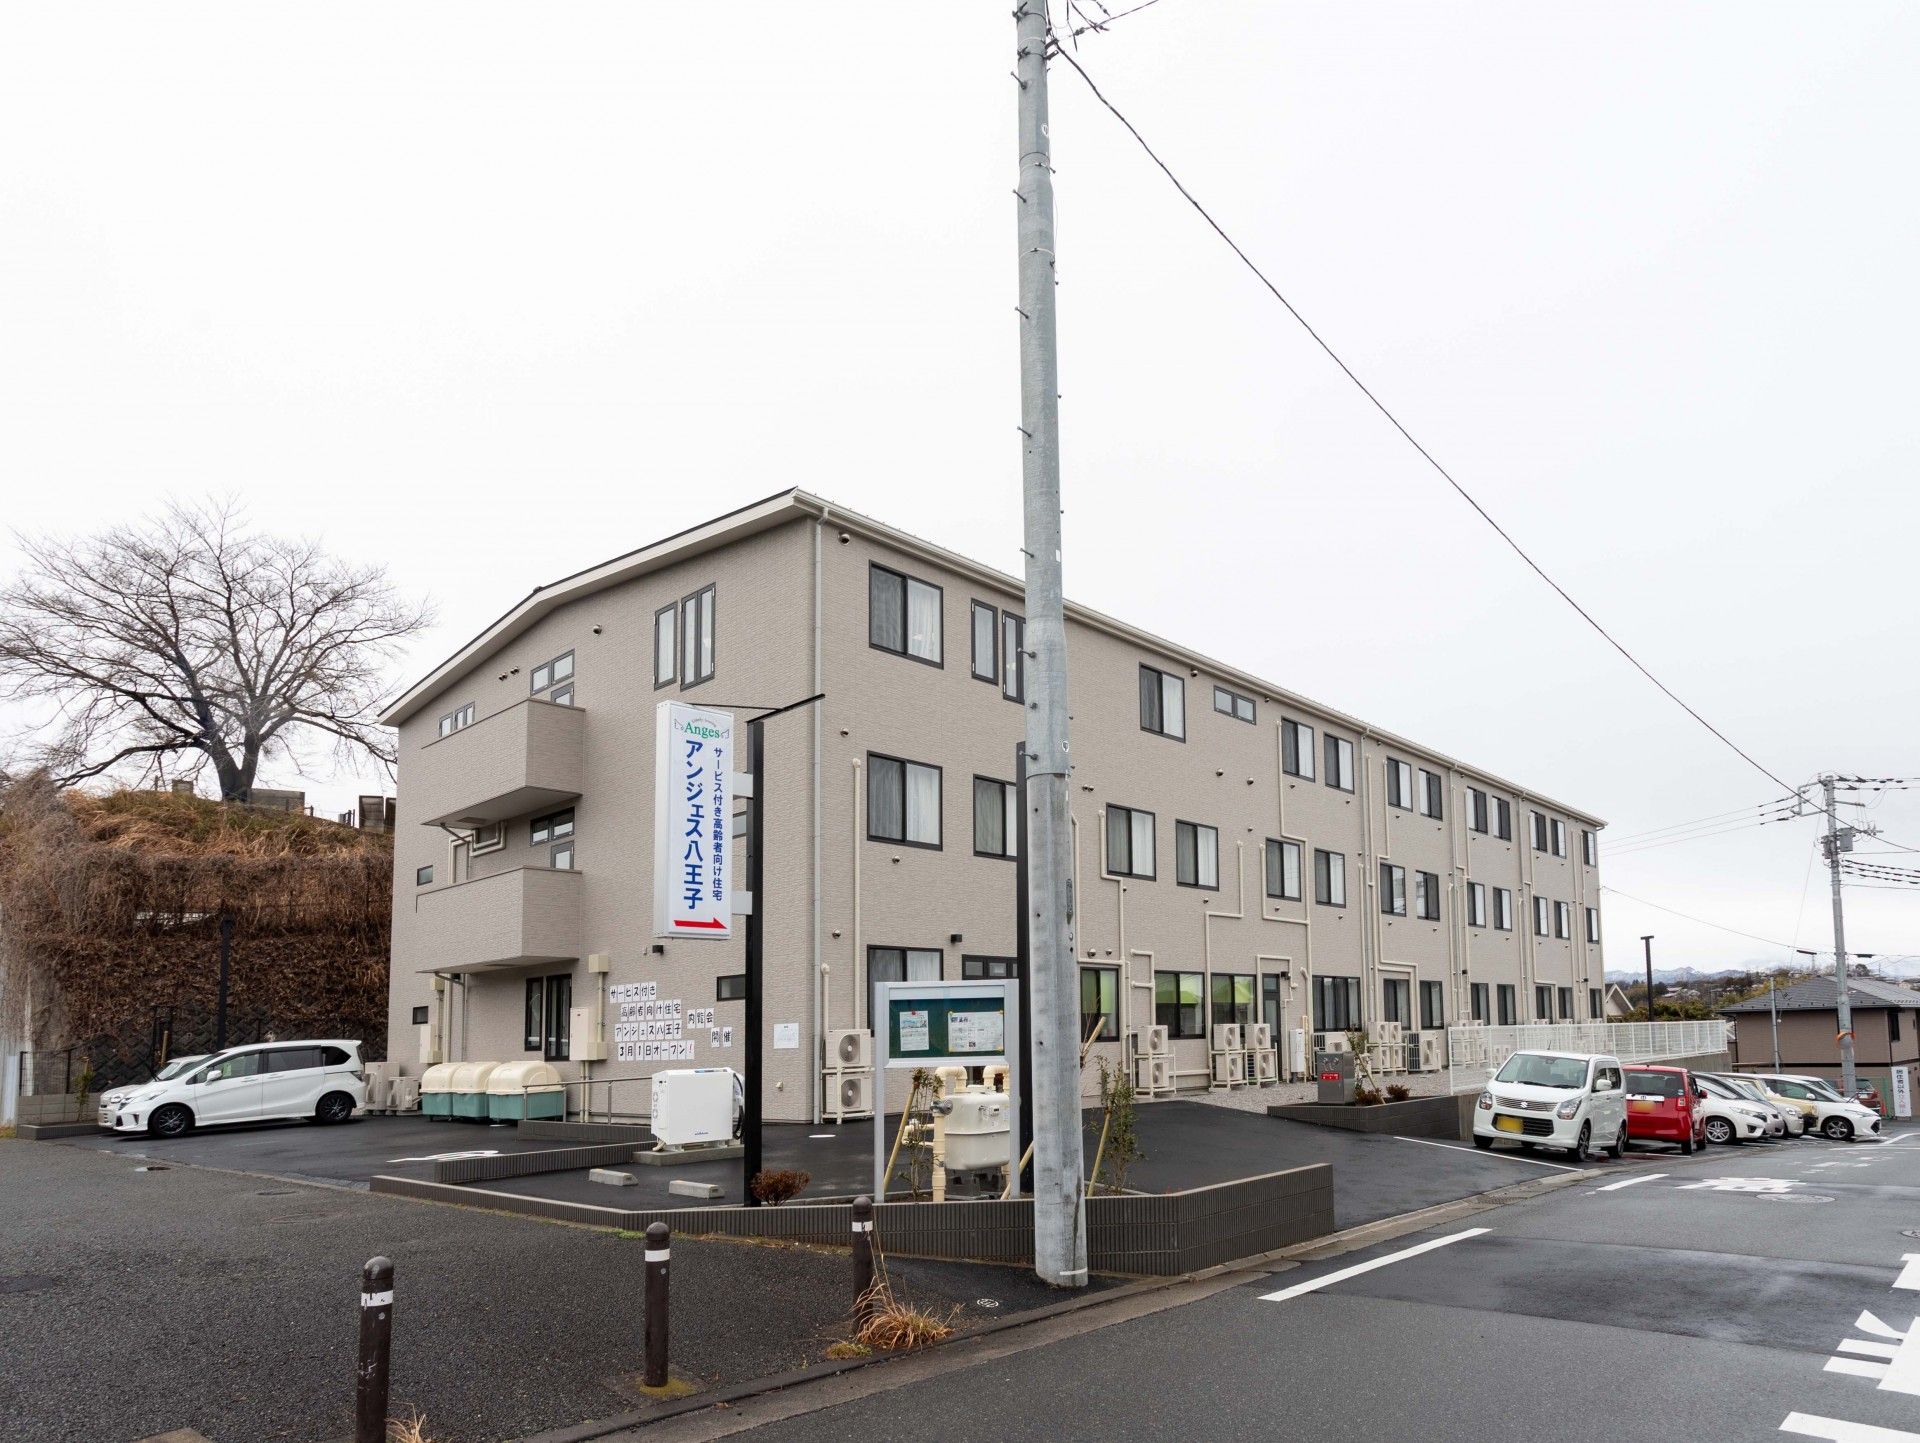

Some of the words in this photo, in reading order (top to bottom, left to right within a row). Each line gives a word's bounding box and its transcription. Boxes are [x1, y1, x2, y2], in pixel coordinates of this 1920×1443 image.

[684, 721, 720, 739] Anges
[683, 739, 705, 910] アンジェス八王子
[712, 747, 724, 902] サービス付き高齢者向け住宅
